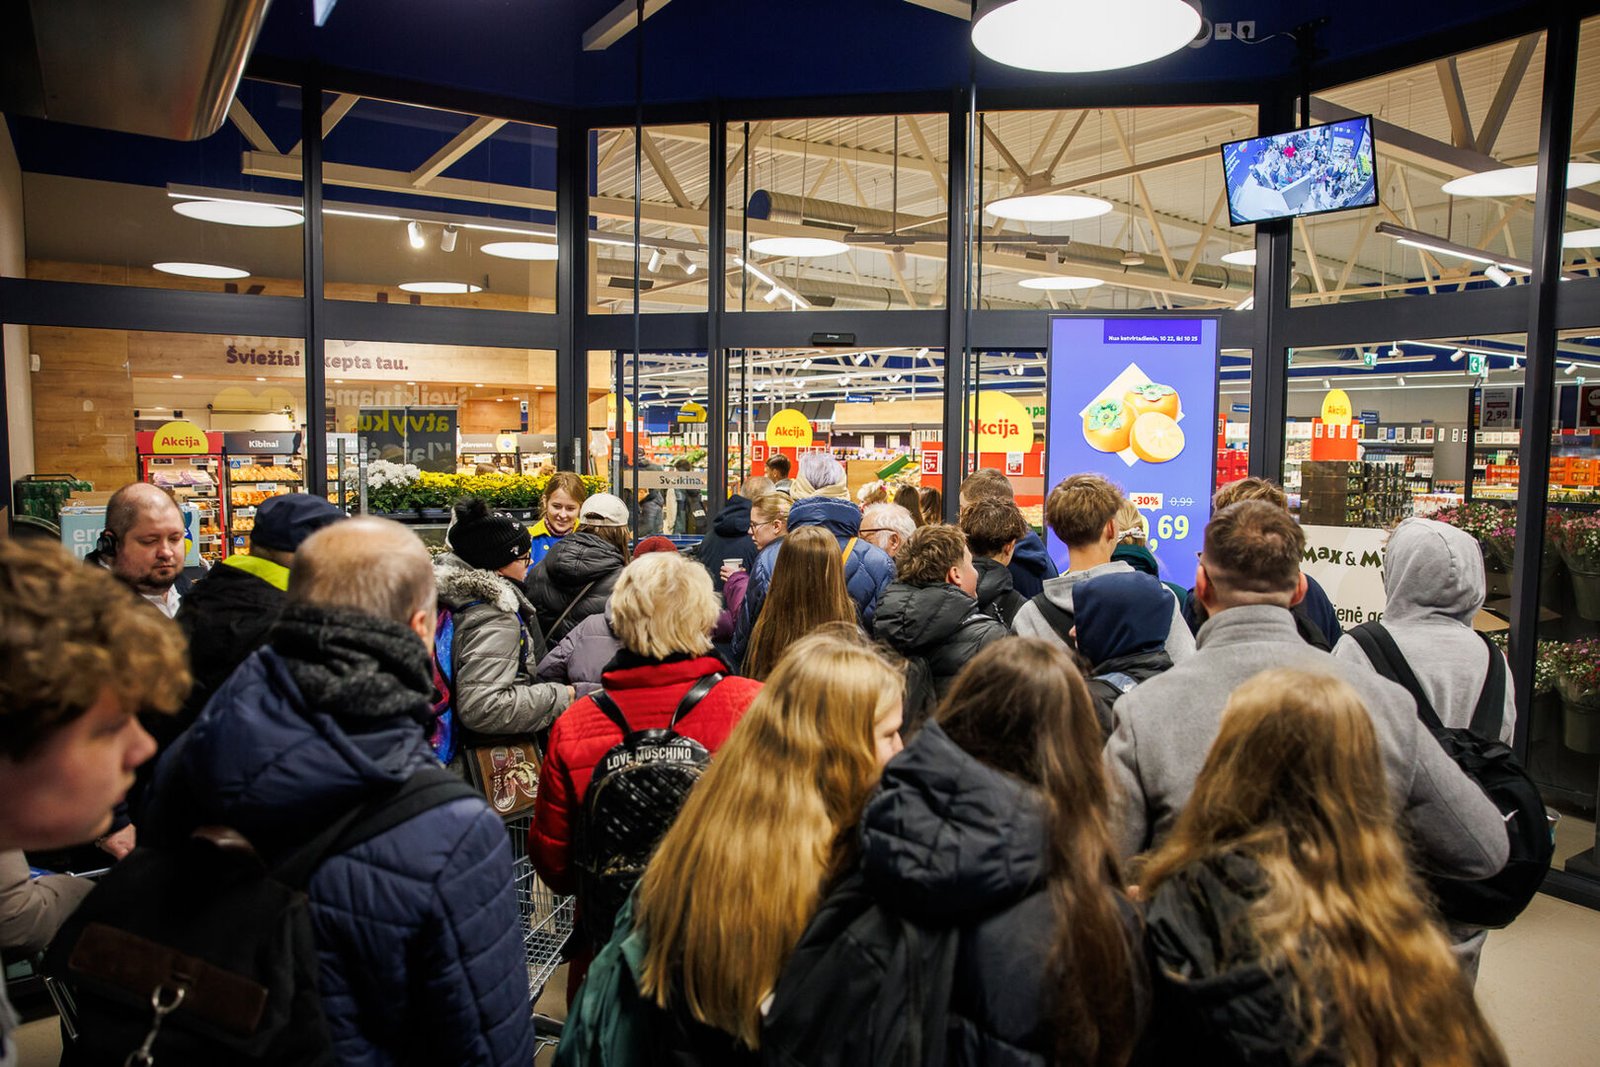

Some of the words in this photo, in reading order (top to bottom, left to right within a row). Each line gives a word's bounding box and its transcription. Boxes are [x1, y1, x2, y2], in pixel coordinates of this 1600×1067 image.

[226, 345, 300, 366] Šviežiai
[376, 356, 409, 370] tau.
[1486, 409, 1508, 421] 2.99
[774, 426, 805, 439] Akcija
[967, 418, 1020, 439] Akcija
[161, 436, 200, 448] Akcija
[248, 440, 279, 448] Kibinai
[1133, 496, 1159, 505] -30%
[1303, 546, 1343, 565] Max
[1345, 551, 1357, 566] &
[1333, 604, 1363, 623] enė
[607, 751, 634, 770] LOVE
[636, 746, 692, 762] MOSCHINO
